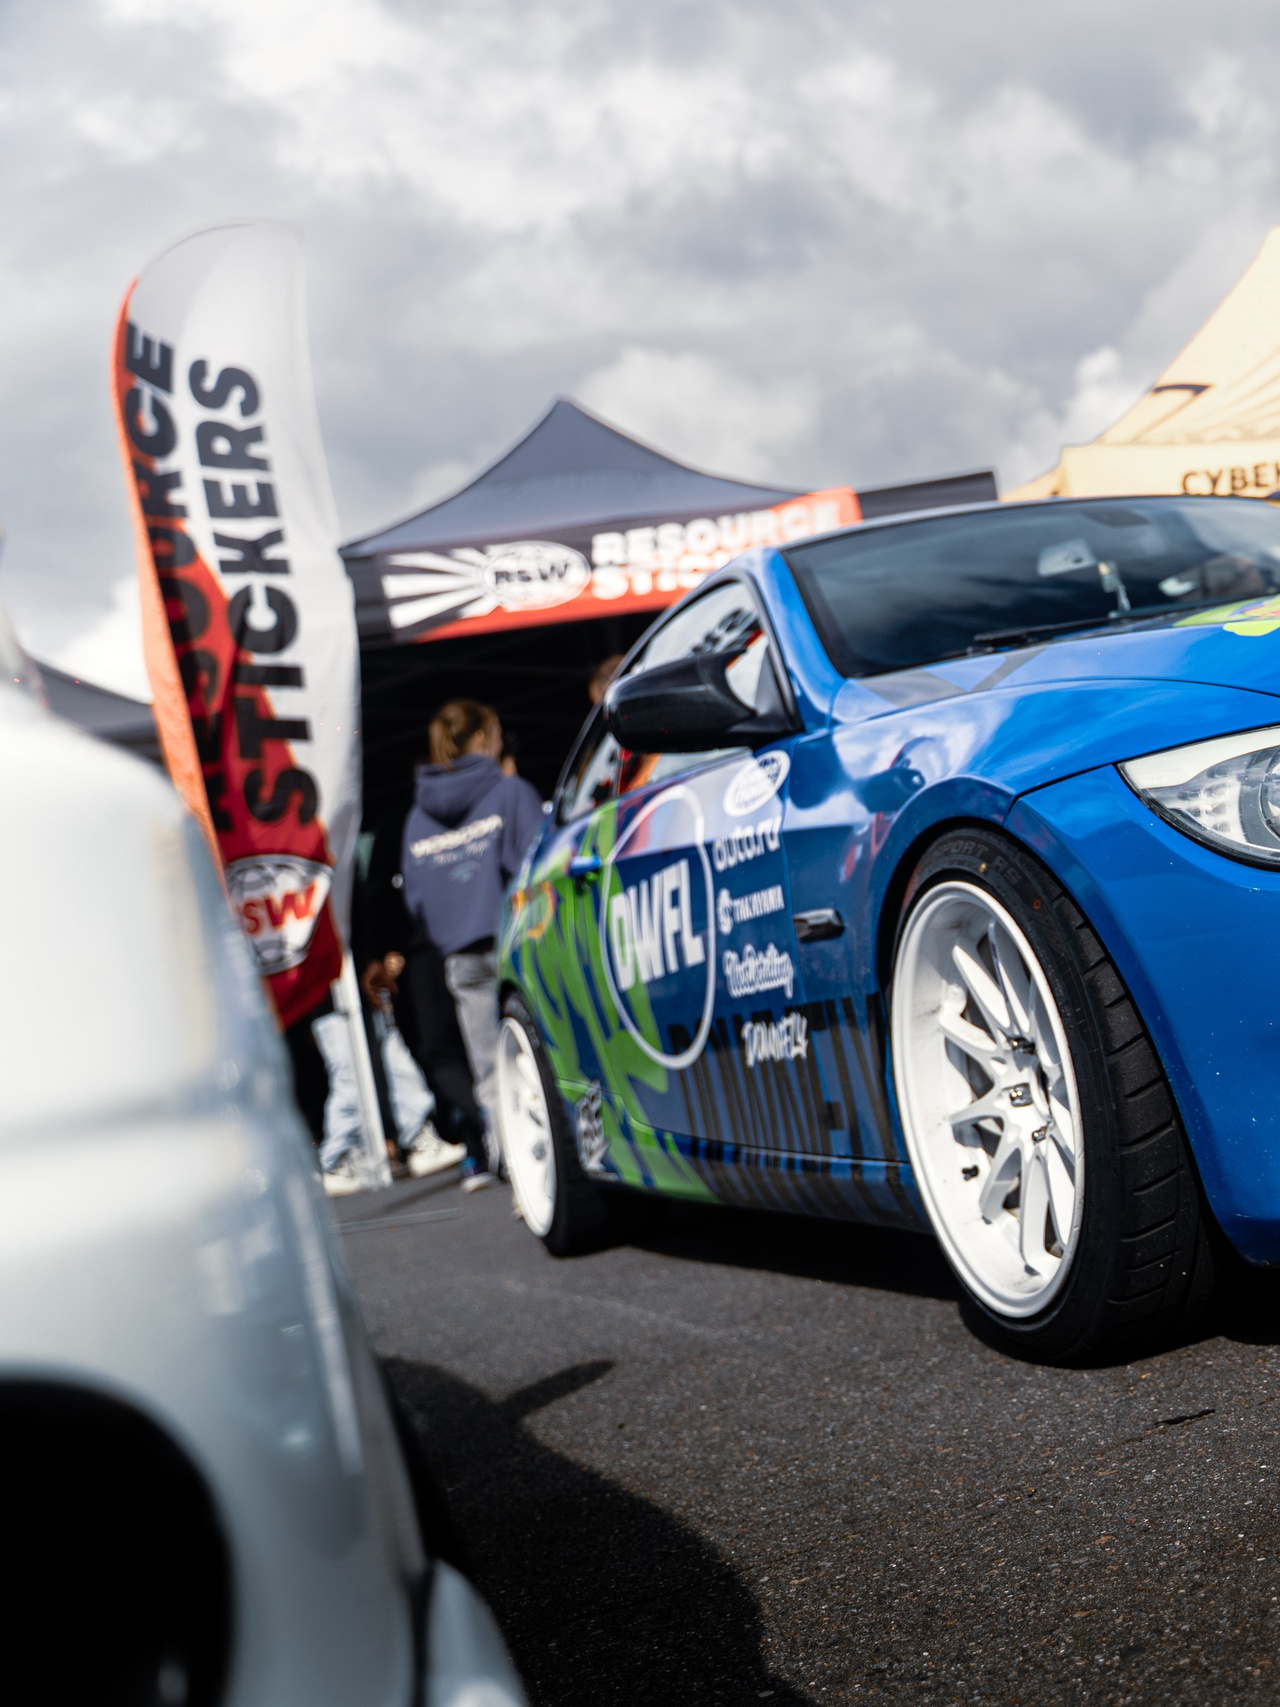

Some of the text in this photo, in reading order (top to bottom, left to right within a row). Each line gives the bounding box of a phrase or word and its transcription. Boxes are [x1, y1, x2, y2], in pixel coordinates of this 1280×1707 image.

[591, 500, 841, 567] RESOURCE
[188, 358, 319, 825] STICKERS
[236, 880, 316, 935] SW
[610, 858, 706, 992] DWFL
[733, 883, 785, 925] TAKAYAMA
